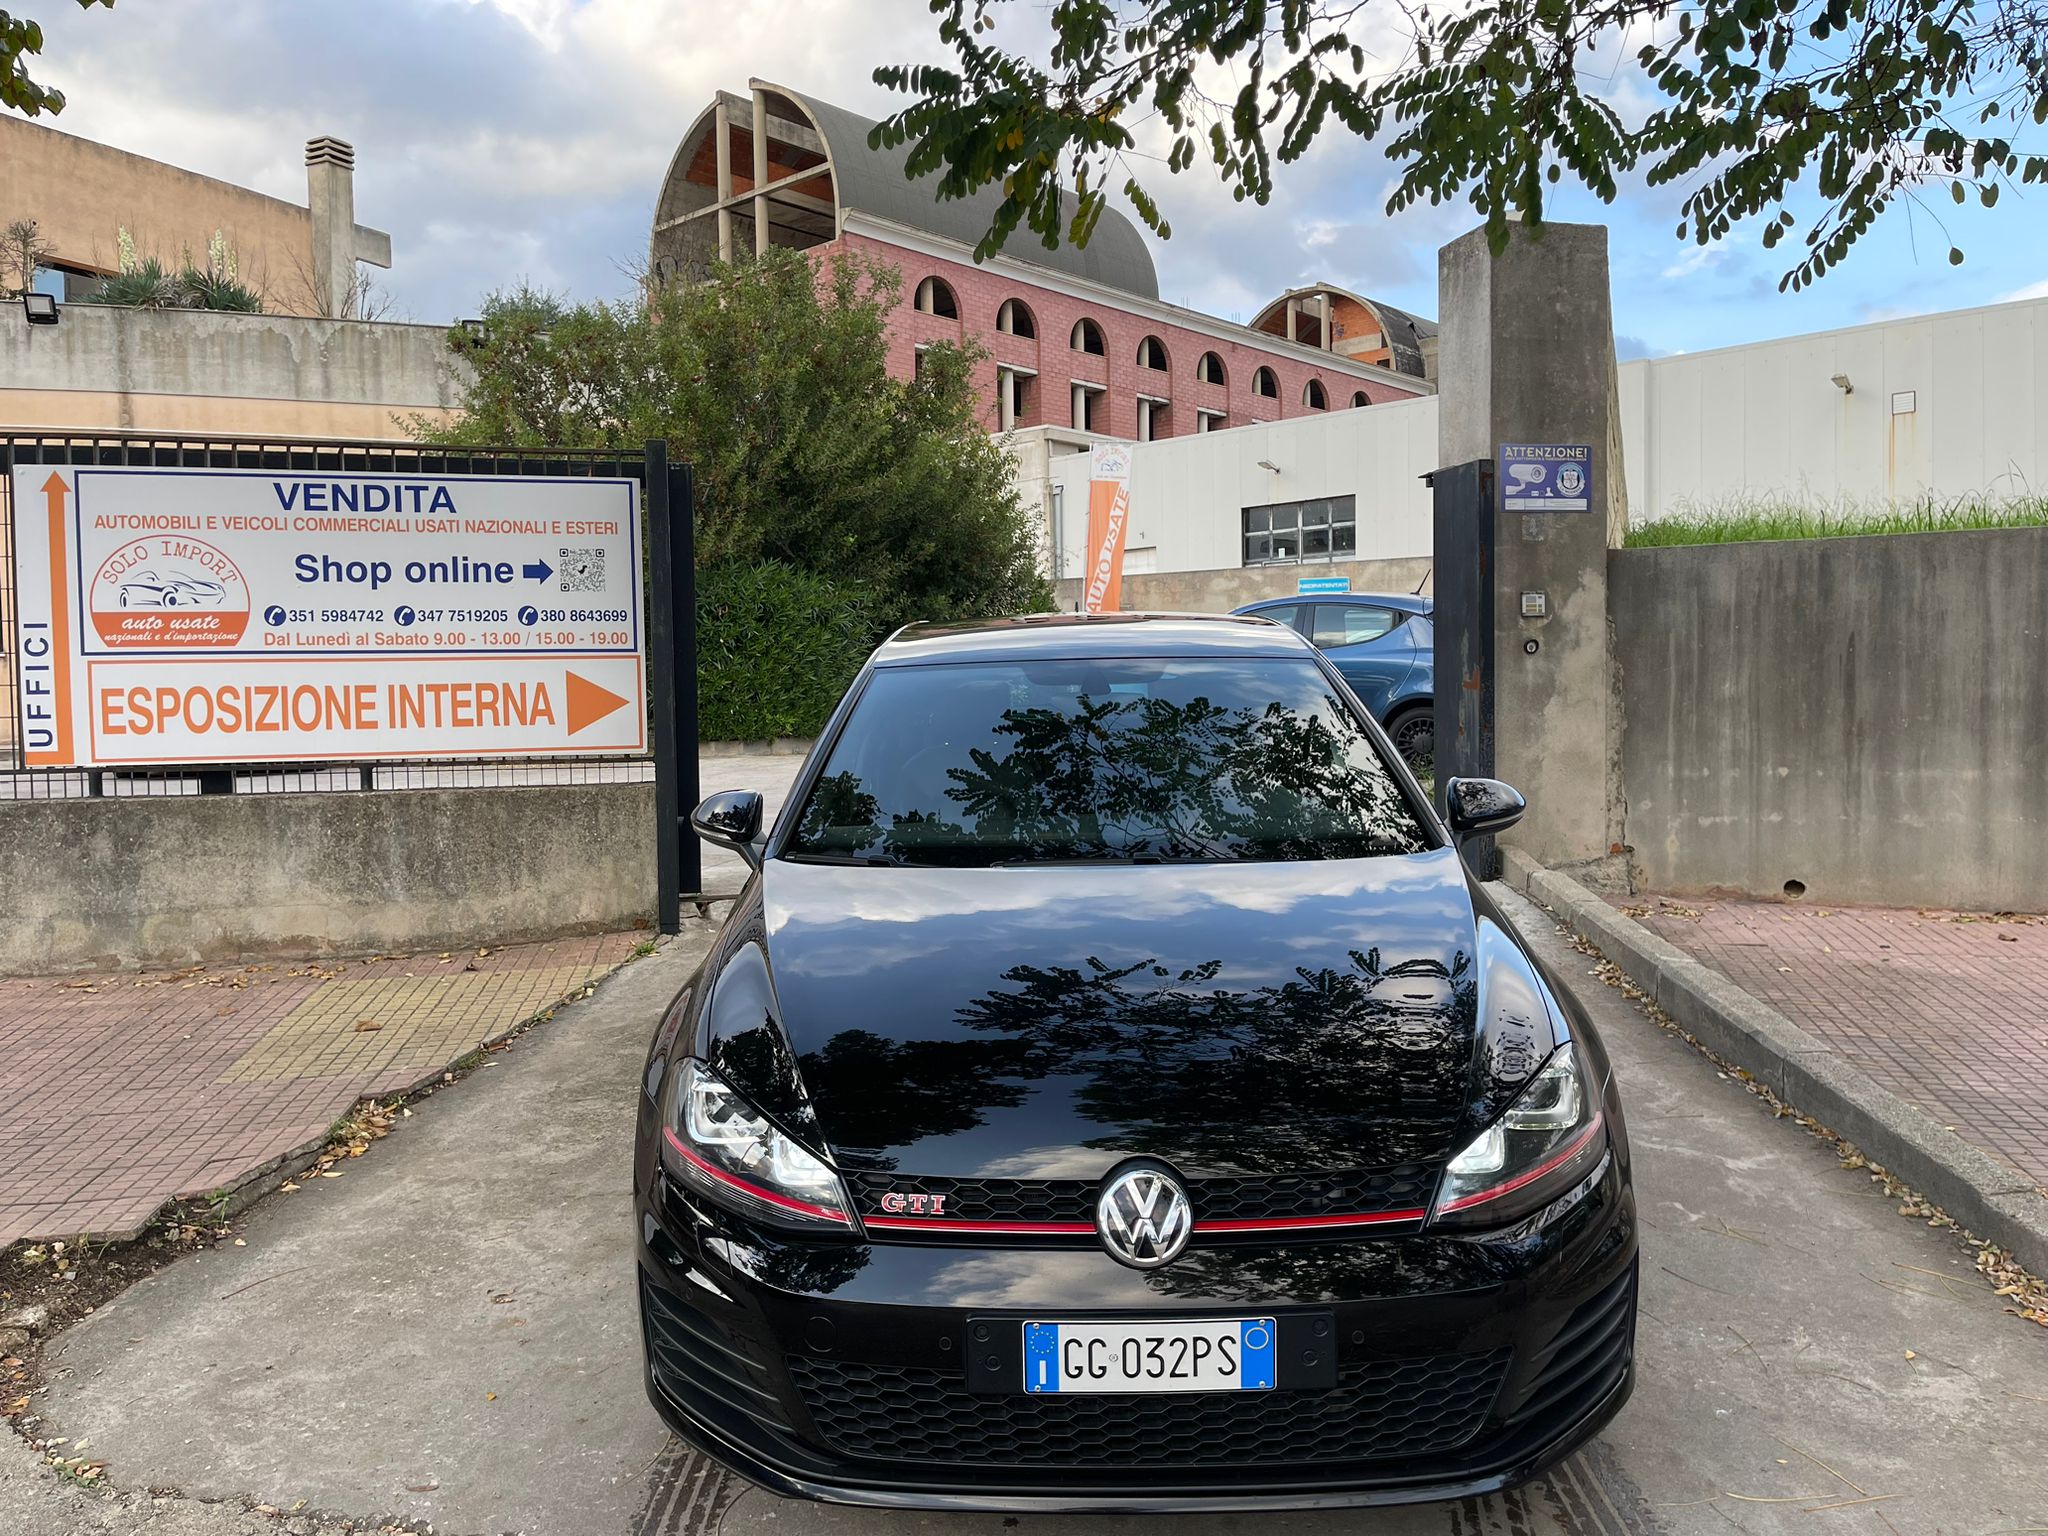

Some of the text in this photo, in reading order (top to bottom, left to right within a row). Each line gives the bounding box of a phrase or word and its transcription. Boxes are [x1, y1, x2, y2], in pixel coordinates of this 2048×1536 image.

[1505, 447, 1587, 458] ATTENZIONE!
[273, 482, 457, 513] VENDITA
[94, 515, 618, 535] AUTOMOBILI E VEICOLI COMMERCIALI USATI NAZIONALI E ESTERI
[103, 541, 237, 584] SOLO IMPORT
[295, 553, 514, 590] Shop online
[1087, 559, 1111, 614] AUTO
[122, 615, 221, 630] auto usate
[289, 610, 384, 622] 351 5984742
[418, 610, 508, 622] 347 7519205
[540, 610, 627, 622] 380 8643699
[104, 631, 151, 644] nazionali
[164, 630, 239, 643] d'importazione
[264, 632, 292, 646] Dal
[296, 631, 350, 646] Lunedì
[356, 632, 369, 645] al
[374, 632, 429, 645] Sabato
[433, 632, 466, 645] 9.00
[481, 632, 520, 645] 13.00
[536, 632, 575, 645] 15.00
[590, 632, 628, 645] 19.00
[23, 623, 53, 748] UFFICI
[101, 682, 556, 735] ESPOSIZIONE INTERNA
[881, 1192, 946, 1215] GTI
[1064, 1335, 1236, 1379] GG 032PS
